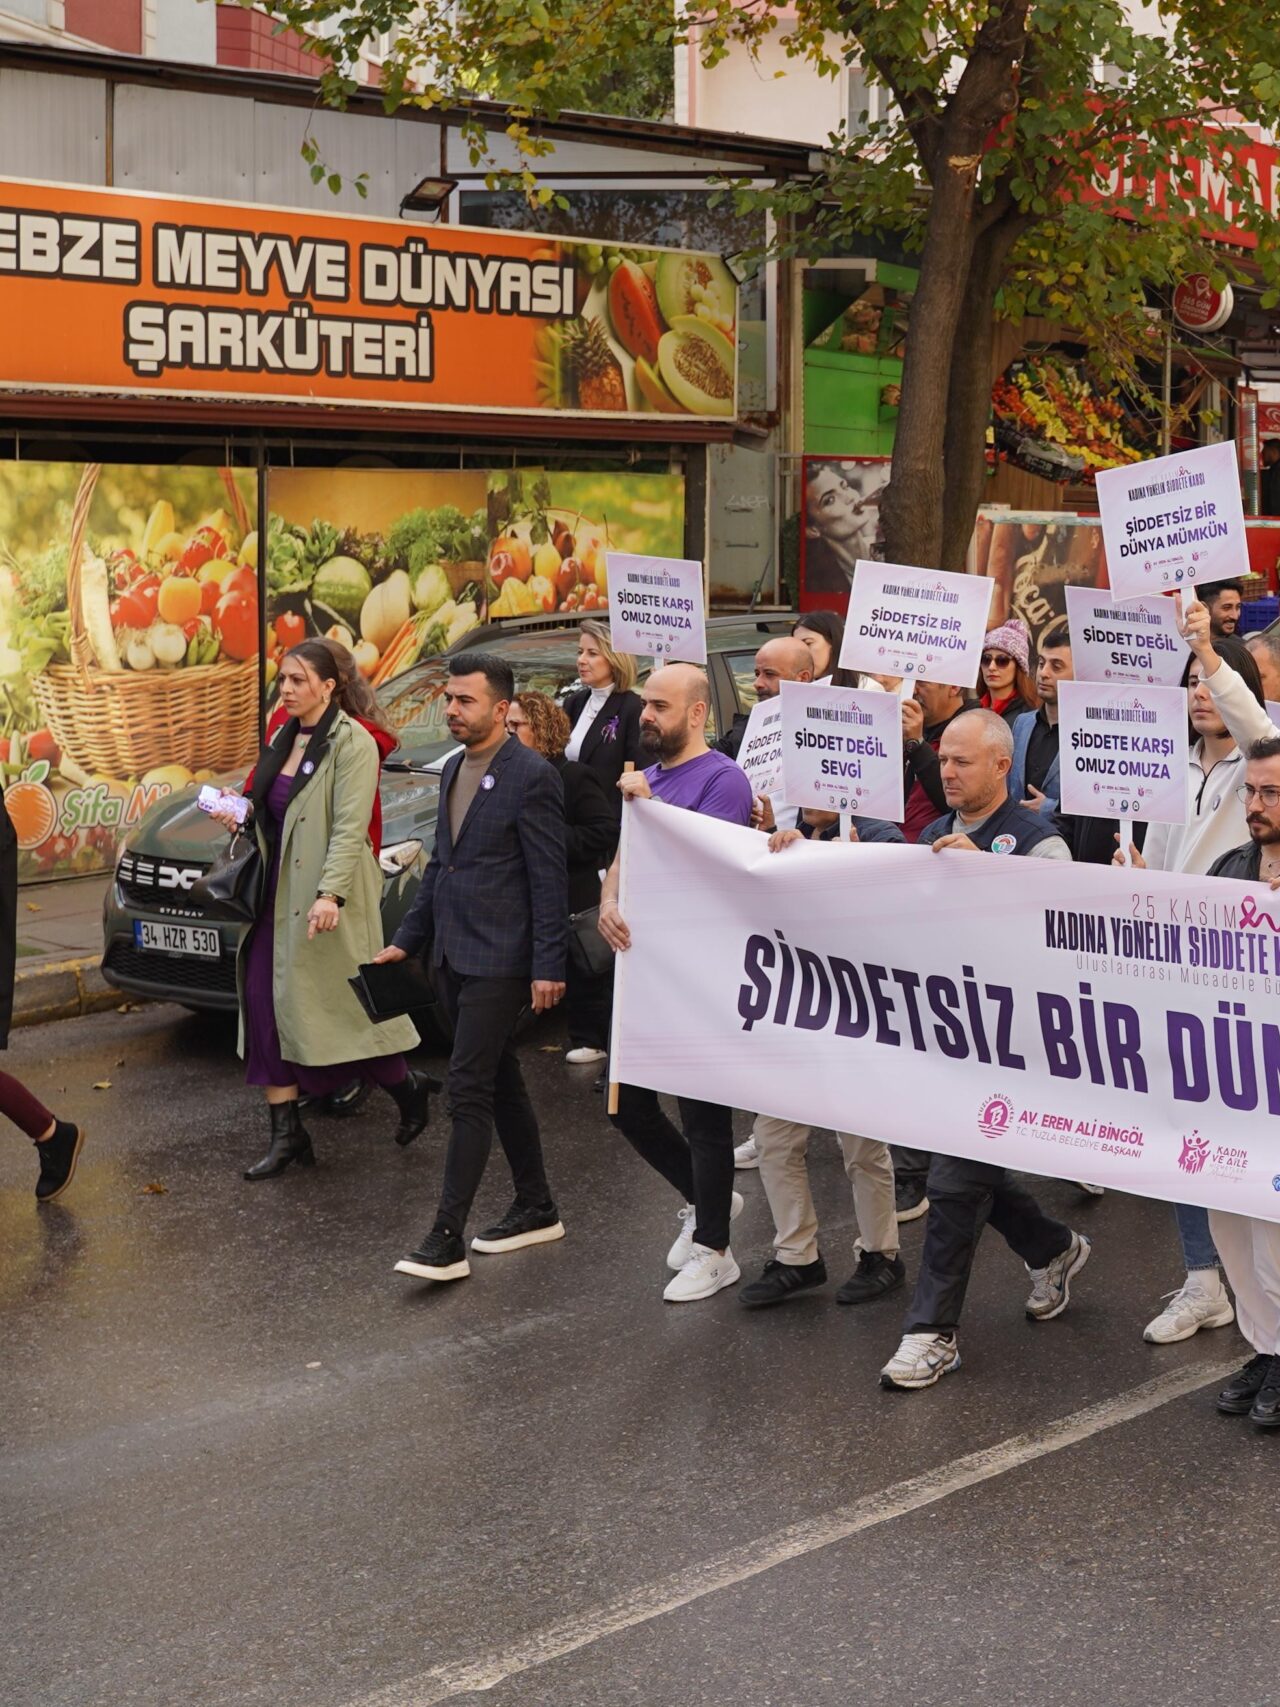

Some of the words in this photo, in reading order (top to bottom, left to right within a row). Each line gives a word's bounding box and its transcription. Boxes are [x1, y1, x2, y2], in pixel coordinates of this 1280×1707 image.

[157, 227, 346, 297] MEYVE
[363, 242, 574, 315] DÜNYASI
[128, 305, 431, 378] ŞARKÜTERİ
[1125, 506, 1193, 537] ŞİDDETSİZ
[1195, 501, 1216, 519] BİR
[1120, 537, 1165, 557] DÜNYA
[1167, 521, 1228, 547] MÜMKÜN
[617, 588, 660, 607] ŞİDDETE
[662, 597, 693, 612] KARŞI
[621, 610, 652, 624] OMUZ
[653, 614, 692, 629] OMUZA
[871, 606, 938, 629] ŞİDDETSİZ
[940, 617, 961, 632] BİR
[859, 624, 903, 641] DÜNYA
[906, 631, 967, 650] MÜMKÜN
[1083, 625, 1132, 647] ŞİDDET
[1135, 633, 1178, 652] DEĞİL
[1111, 651, 1152, 669] SEVGİ
[795, 727, 843, 751] ŞİDDET
[846, 736, 887, 758] DEĞİL
[1071, 728, 1128, 751] ŞİDDETE
[1131, 736, 1174, 757] KARŞI
[743, 750, 769, 770] OMUZ
[821, 759, 861, 779] SEVGİ
[1075, 757, 1115, 775] OMUZ
[1118, 760, 1171, 780] OMUZA
[62, 786, 121, 836] Şifa
[1132, 893, 1155, 920] 25
[1170, 897, 1237, 929] KASIM
[142, 924, 158, 946] 34
[164, 927, 187, 950] HZR
[193, 929, 218, 953] 530
[1045, 908, 1107, 955] KADINA
[1110, 916, 1182, 964] YÖNELİK
[1188, 925, 1268, 975] ŞİDDETE
[1076, 954, 1172, 981] Uluslararası
[1180, 968, 1255, 992] Mücadele
[737, 928, 1026, 1071] ŞİDDETSİZ
[1037, 981, 1148, 1094] BİR
[977, 1096, 993, 1117] TUZLA
[1018, 1110, 1039, 1126] AV.
[1040, 1113, 1074, 1133] EREN
[1075, 1117, 1097, 1137] ALİ
[1097, 1121, 1145, 1147] BİNGÖL
[1031, 1129, 1057, 1143] TUZLA
[1059, 1135, 1100, 1151] BELEDİYE
[1101, 1143, 1142, 1159] BAŞKANI
[1216, 1146, 1248, 1159] KADIN
[1212, 1154, 1224, 1164] VE
[1226, 1157, 1249, 1169] AİLE
